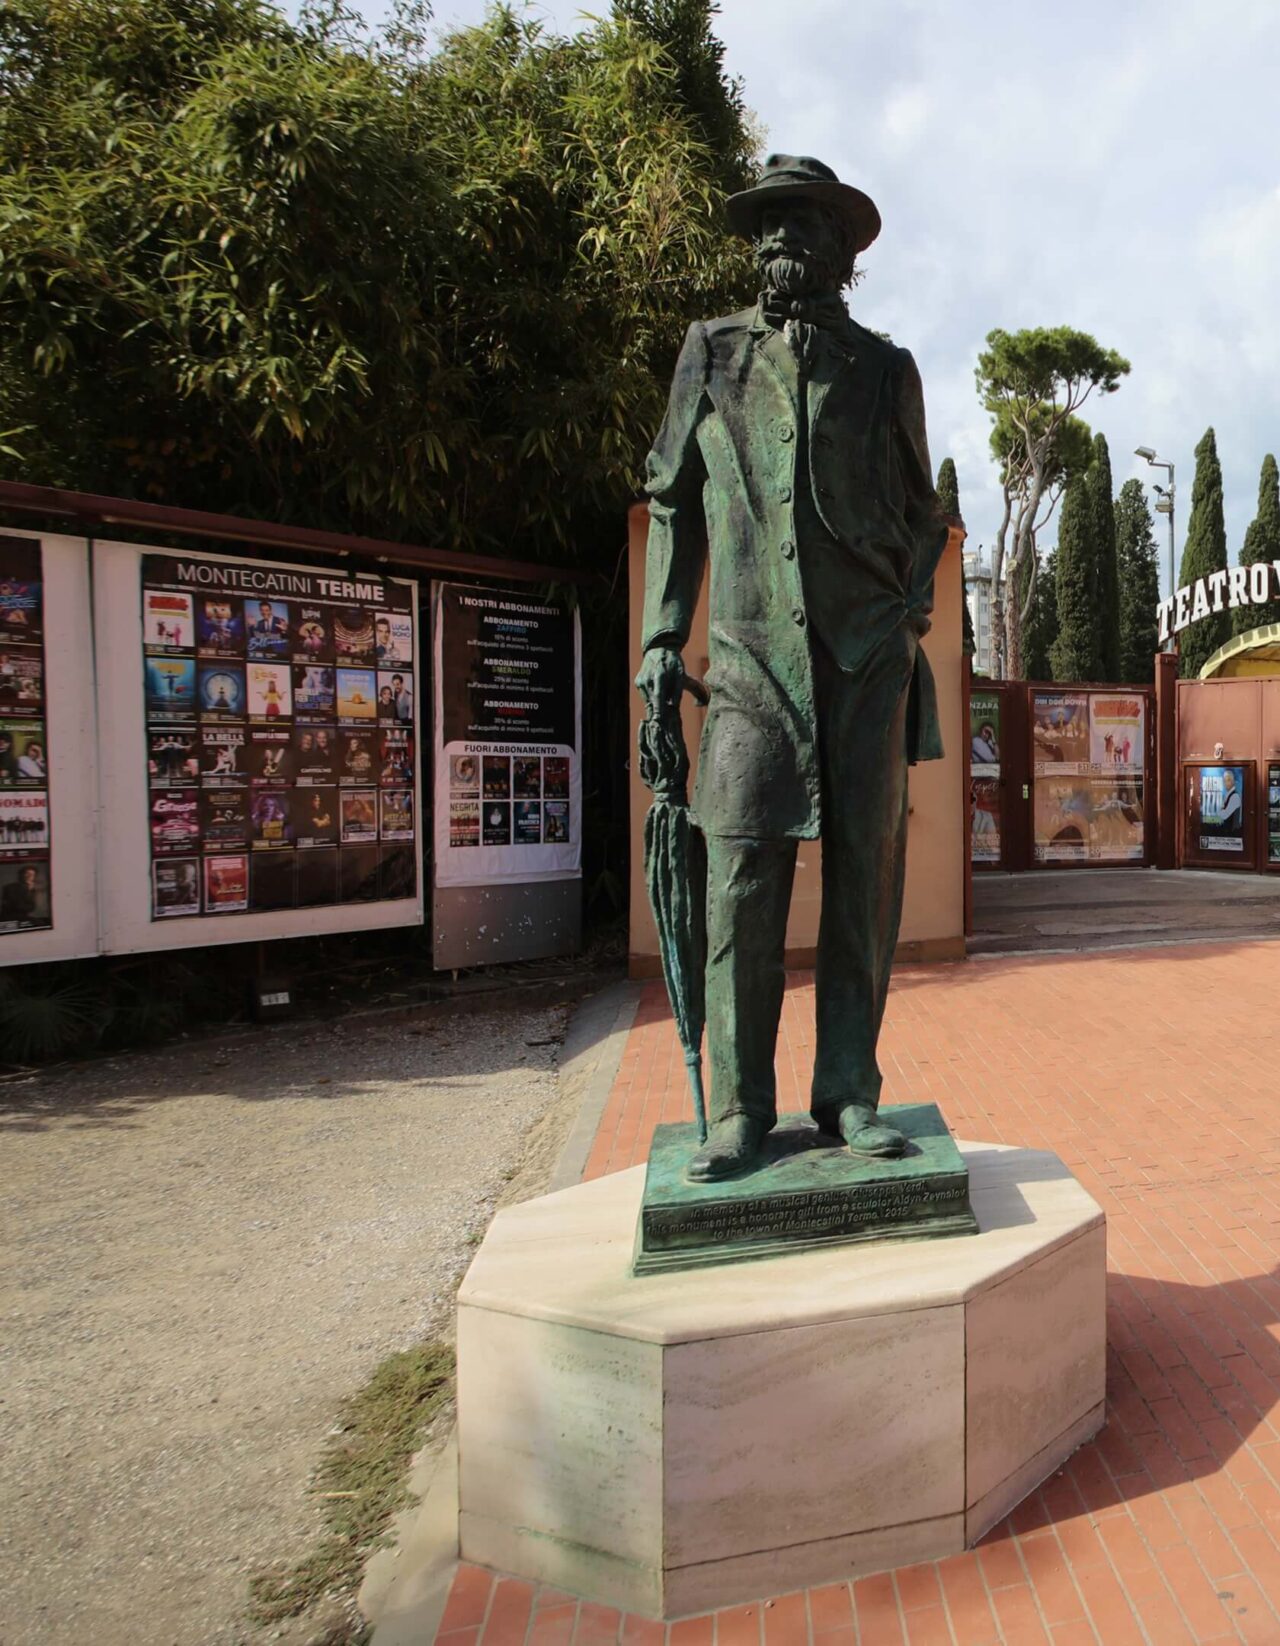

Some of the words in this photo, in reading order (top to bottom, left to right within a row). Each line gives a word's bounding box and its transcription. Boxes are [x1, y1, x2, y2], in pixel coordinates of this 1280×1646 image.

[177, 563, 312, 594] MONTECATINI
[316, 579, 385, 602] TERME
[464, 597, 498, 609] NOSTRI
[499, 601, 560, 616] ABBONAMENTI
[1156, 563, 1269, 643] TEATRO
[483, 616, 539, 629] ABBONAMENTO
[483, 658, 539, 669] ABBONAMENTO
[483, 700, 539, 711] ABBONAMENTO
[464, 744, 491, 753] FUORI
[493, 745, 557, 755] ABBONAMENTO
[449, 802, 479, 812] NEGRITA
[669, 1217, 726, 1232] monument
[749, 1210, 794, 1223] honorary
[817, 1203, 840, 1215] from
[851, 1197, 892, 1211] sculptor
[923, 1188, 966, 1203] Zeynalov
[703, 1202, 745, 1217] memory
[769, 1194, 810, 1209] musical
[745, 1224, 770, 1236] town
